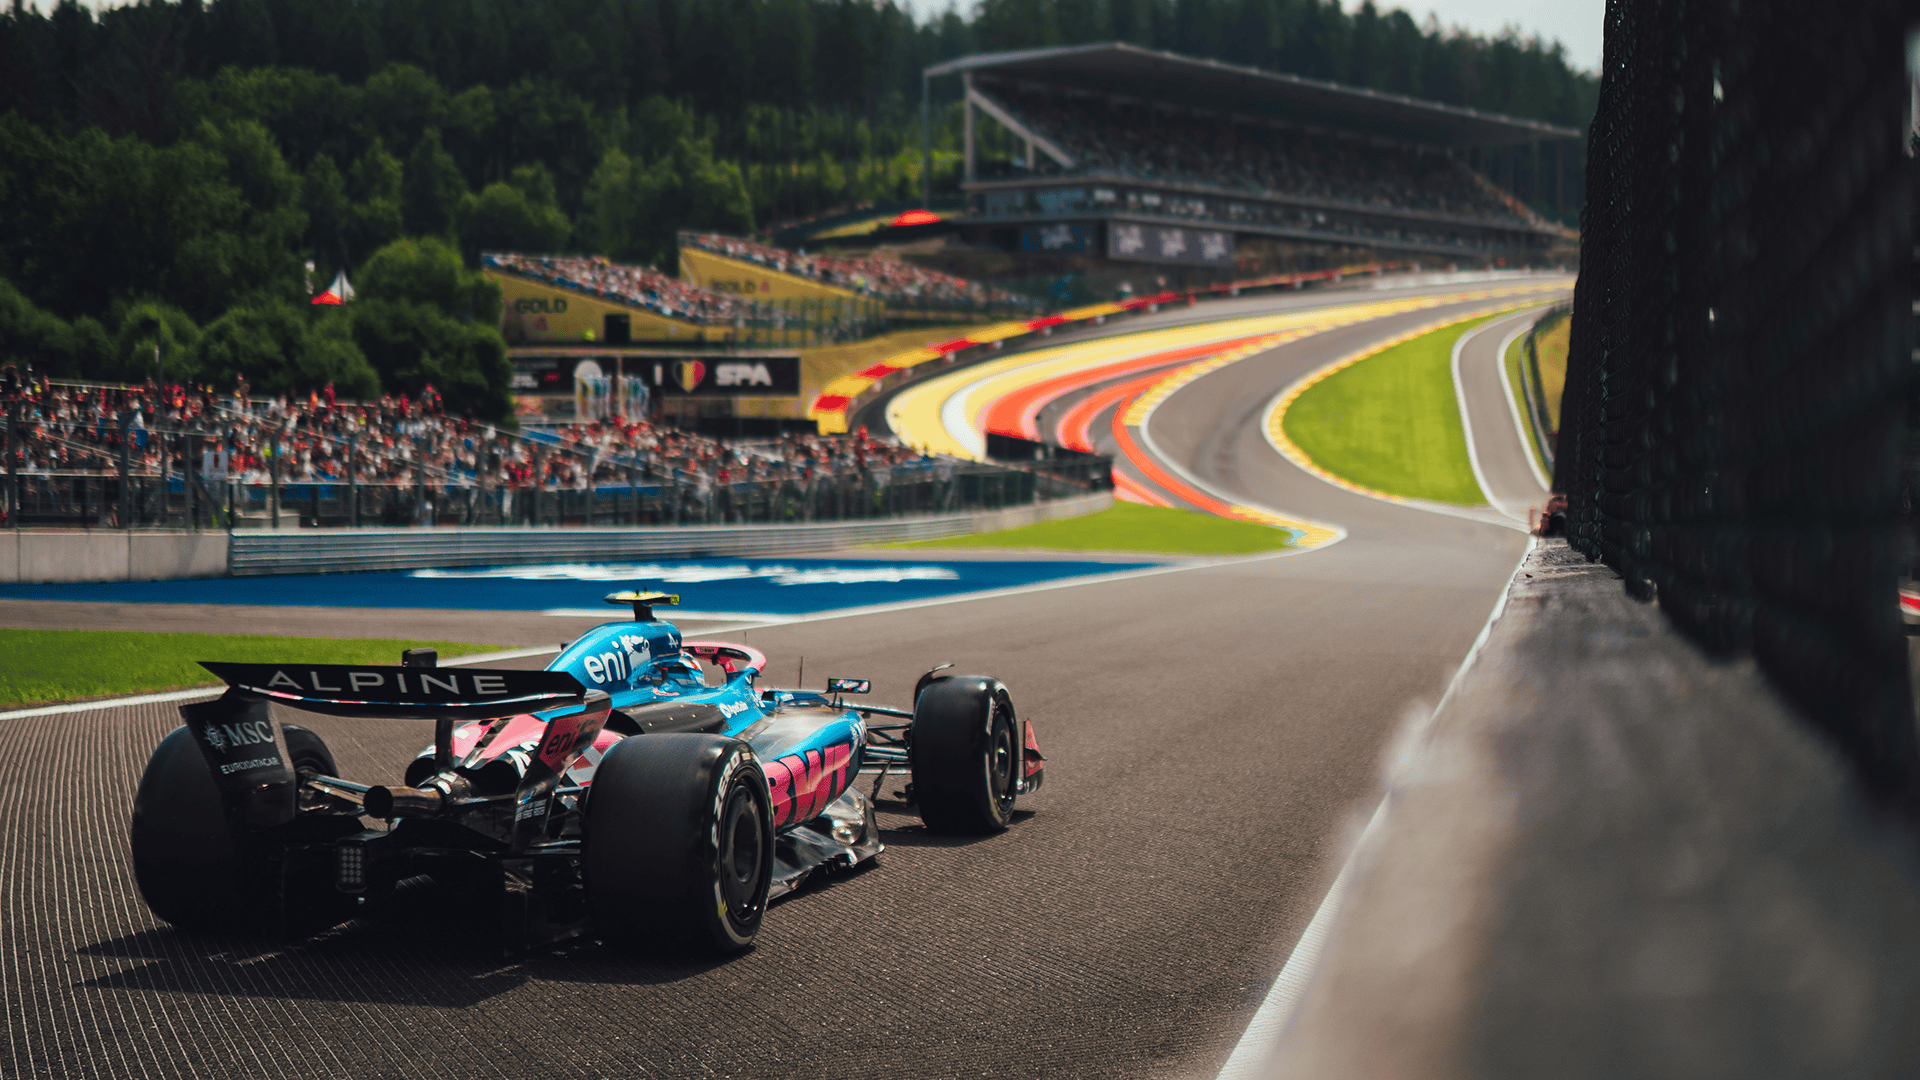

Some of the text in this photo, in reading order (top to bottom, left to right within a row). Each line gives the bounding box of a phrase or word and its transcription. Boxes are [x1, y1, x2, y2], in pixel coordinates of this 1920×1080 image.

[514, 297, 568, 314] GOLD
[715, 363, 772, 387] SPA
[583, 640, 627, 685] eni
[267, 670, 508, 695] ALPINE
[221, 720, 274, 747] MSC
[545, 723, 581, 756] eni
[220, 756, 280, 775] EURODATACAR
[762, 742, 851, 829] BWT
